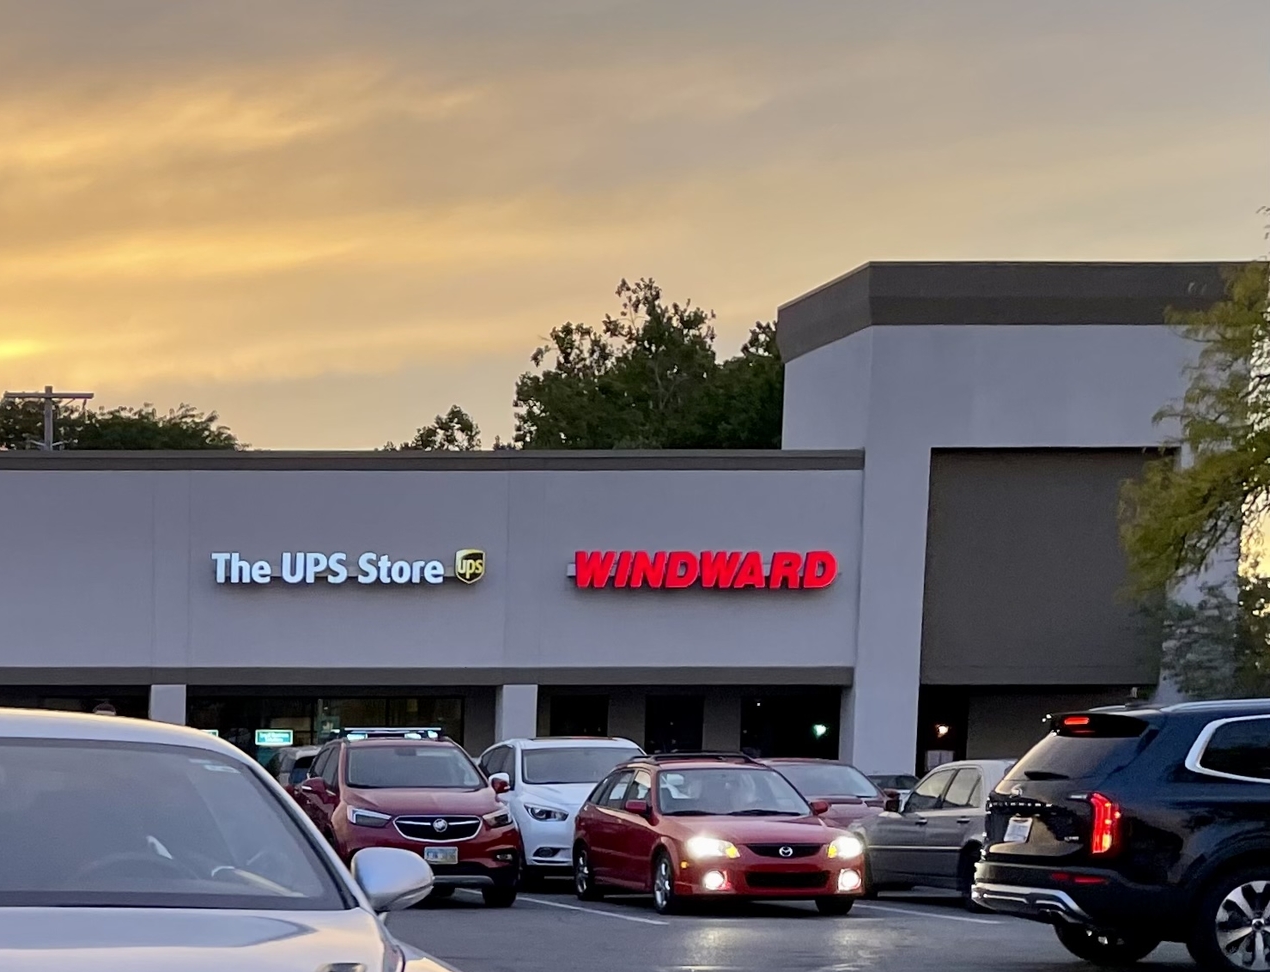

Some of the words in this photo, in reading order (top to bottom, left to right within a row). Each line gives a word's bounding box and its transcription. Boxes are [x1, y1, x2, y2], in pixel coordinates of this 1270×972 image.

[211, 552, 272, 584] The
[281, 552, 348, 584] UPS
[357, 552, 445, 584] Store
[457, 559, 484, 579] ups
[575, 551, 838, 588] WINDWARD
